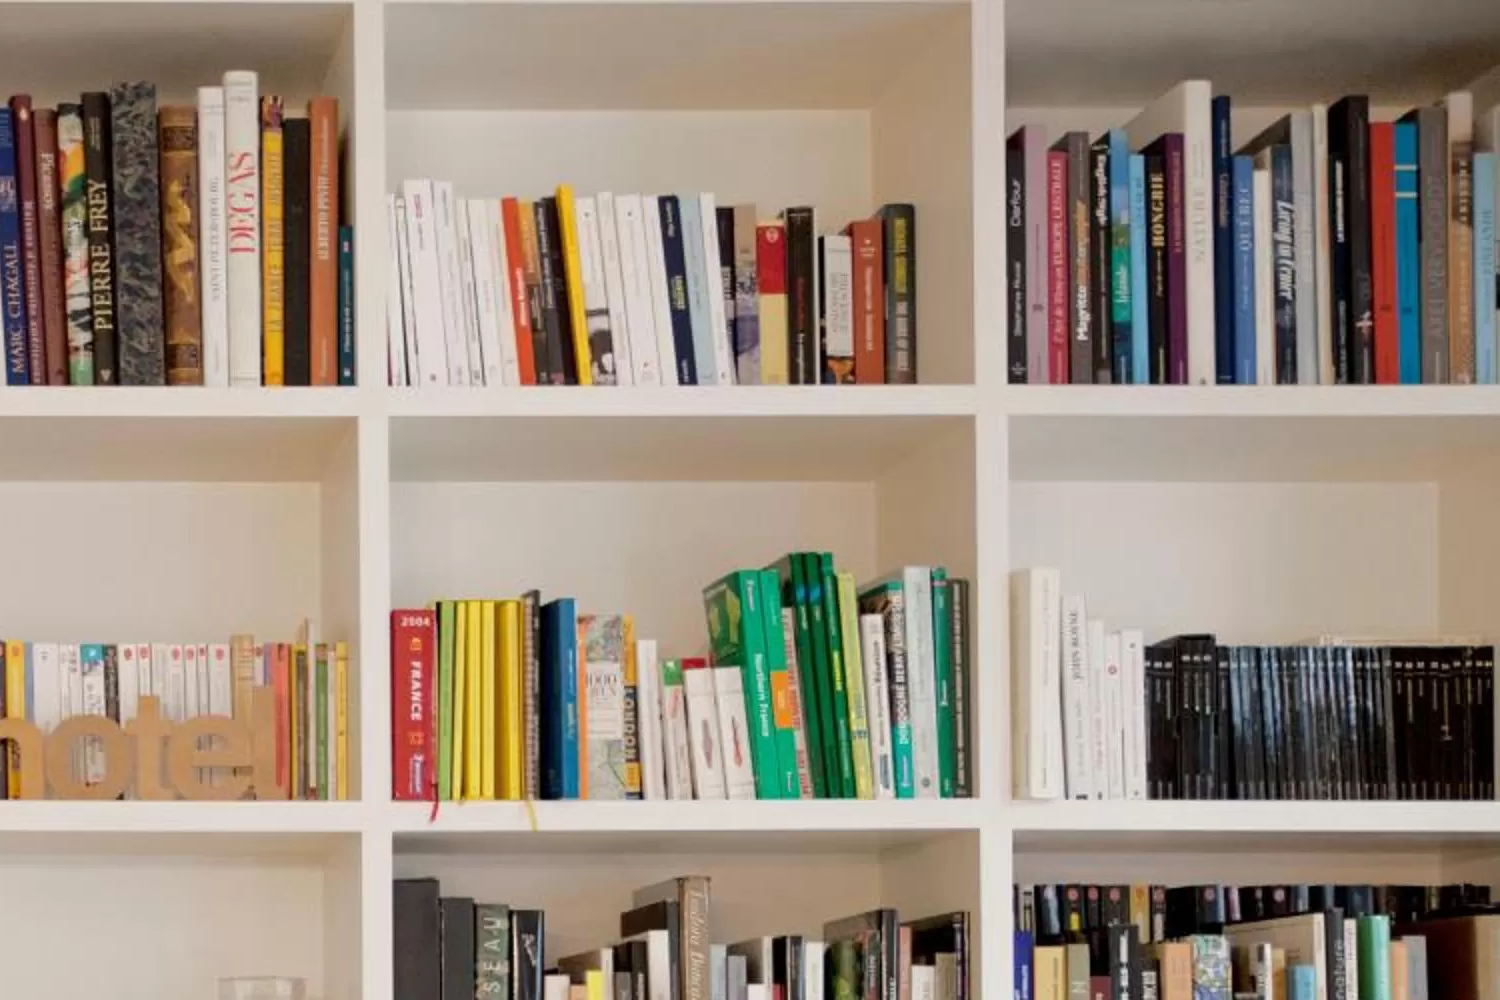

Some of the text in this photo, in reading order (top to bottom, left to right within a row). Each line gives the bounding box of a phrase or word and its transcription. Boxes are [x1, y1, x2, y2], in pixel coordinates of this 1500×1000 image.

[228, 152, 257, 255] DEGAS
[1150, 172, 1164, 247] HONGRIE
[88, 178, 113, 330] PIERRE FREY
[5, 240, 25, 373] MARC CHAGALL
[1076, 285, 1091, 340] Magritte
[410, 661, 424, 721] FRANCE
[623, 687, 637, 762] LONDON
[754, 653, 770, 737] Northern France
